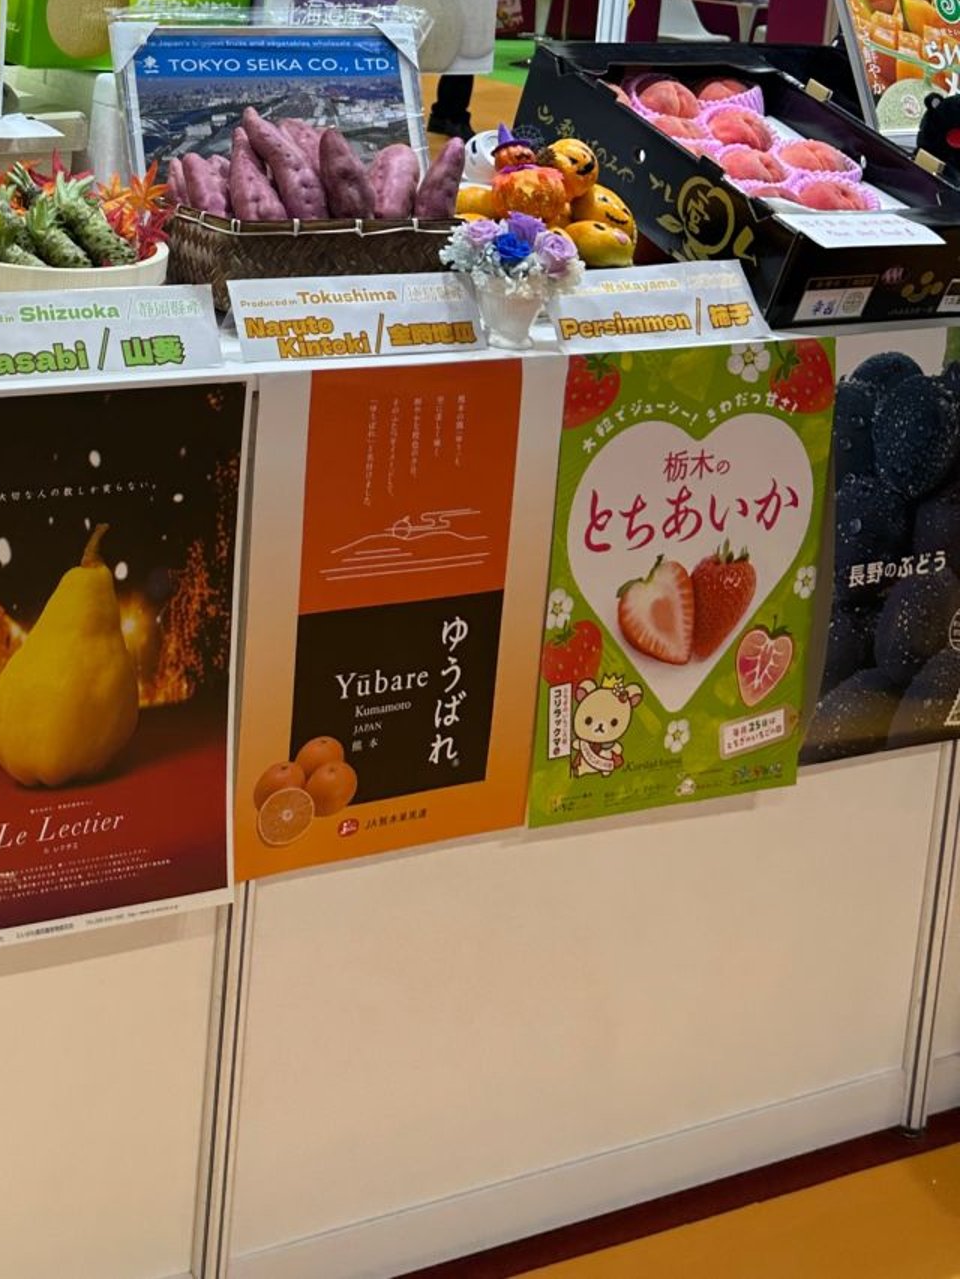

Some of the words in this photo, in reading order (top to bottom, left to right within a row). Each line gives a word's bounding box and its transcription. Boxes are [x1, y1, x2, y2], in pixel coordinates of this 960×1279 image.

[168, 58, 241, 72] TOKYO
[246, 58, 303, 72] SEIKA
[308, 57, 349, 73] CO.,
[354, 57, 395, 71] LTD.
[240, 299, 288, 308] Produced
[297, 287, 397, 306] Tokushima
[601, 279, 679, 293] Wakayama
[19, 303, 120, 323] Shizuoka
[558, 311, 692, 341] Persimmon
[243, 315, 335, 339] Naruto
[277, 331, 371, 359] Kintoki
[662, 448, 731, 483] 栃木の
[584, 477, 800, 552] とちあいか
[847, 550, 947, 588] 長野のぶどう
[335, 668, 430, 700] Yūbare
[427, 616, 469, 765] ゆうばれ
[354, 700, 412, 718] Kumamoto
[353, 721, 383, 736] JAPAN
[351, 737, 379, 753] 熊本
[36, 811, 125, 842] Lectier
